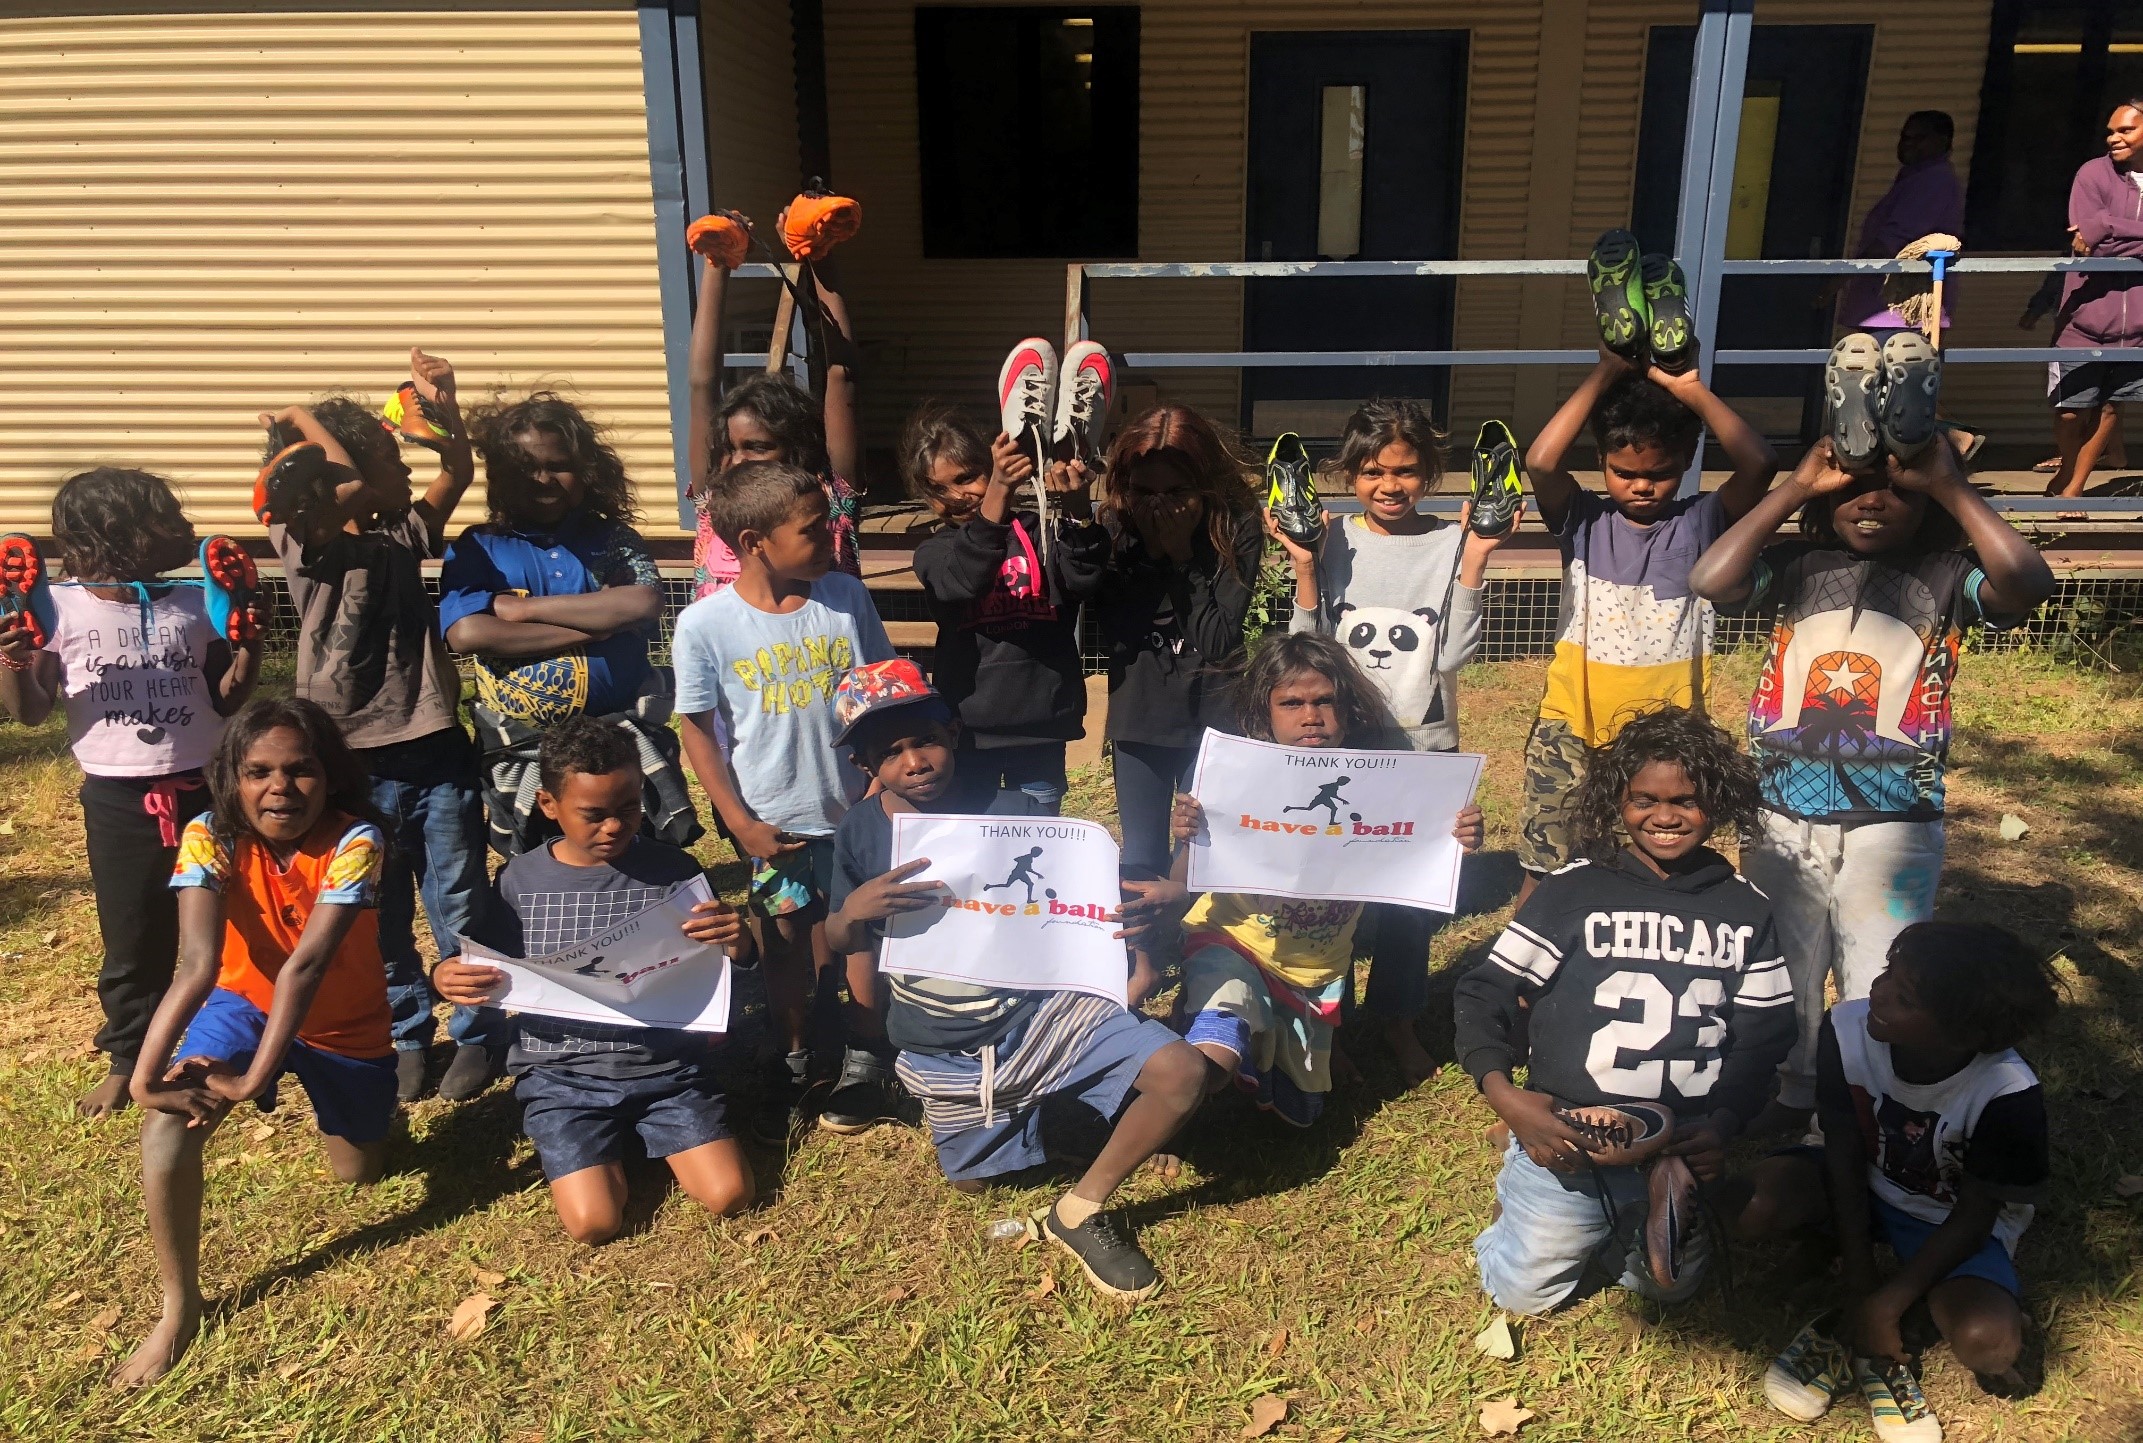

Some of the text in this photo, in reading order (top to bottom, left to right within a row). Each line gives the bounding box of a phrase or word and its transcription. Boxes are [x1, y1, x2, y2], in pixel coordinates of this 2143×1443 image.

[88, 625, 188, 648] A DREAM
[85, 646, 198, 676] is a wish
[731, 634, 852, 692] PIPING
[86, 676, 198, 703] YOUR HEART
[762, 668, 836, 715] HOT
[105, 702, 195, 727] makes
[1284, 754, 1397, 769] THANK YOU!!!
[980, 825, 1087, 841] THANK YOU!!!
[1239, 814, 1415, 836] have a ball
[942, 895, 1106, 922] have a ball
[590, 920, 641, 951] YOU!!!
[1585, 970, 1728, 1099] 23
